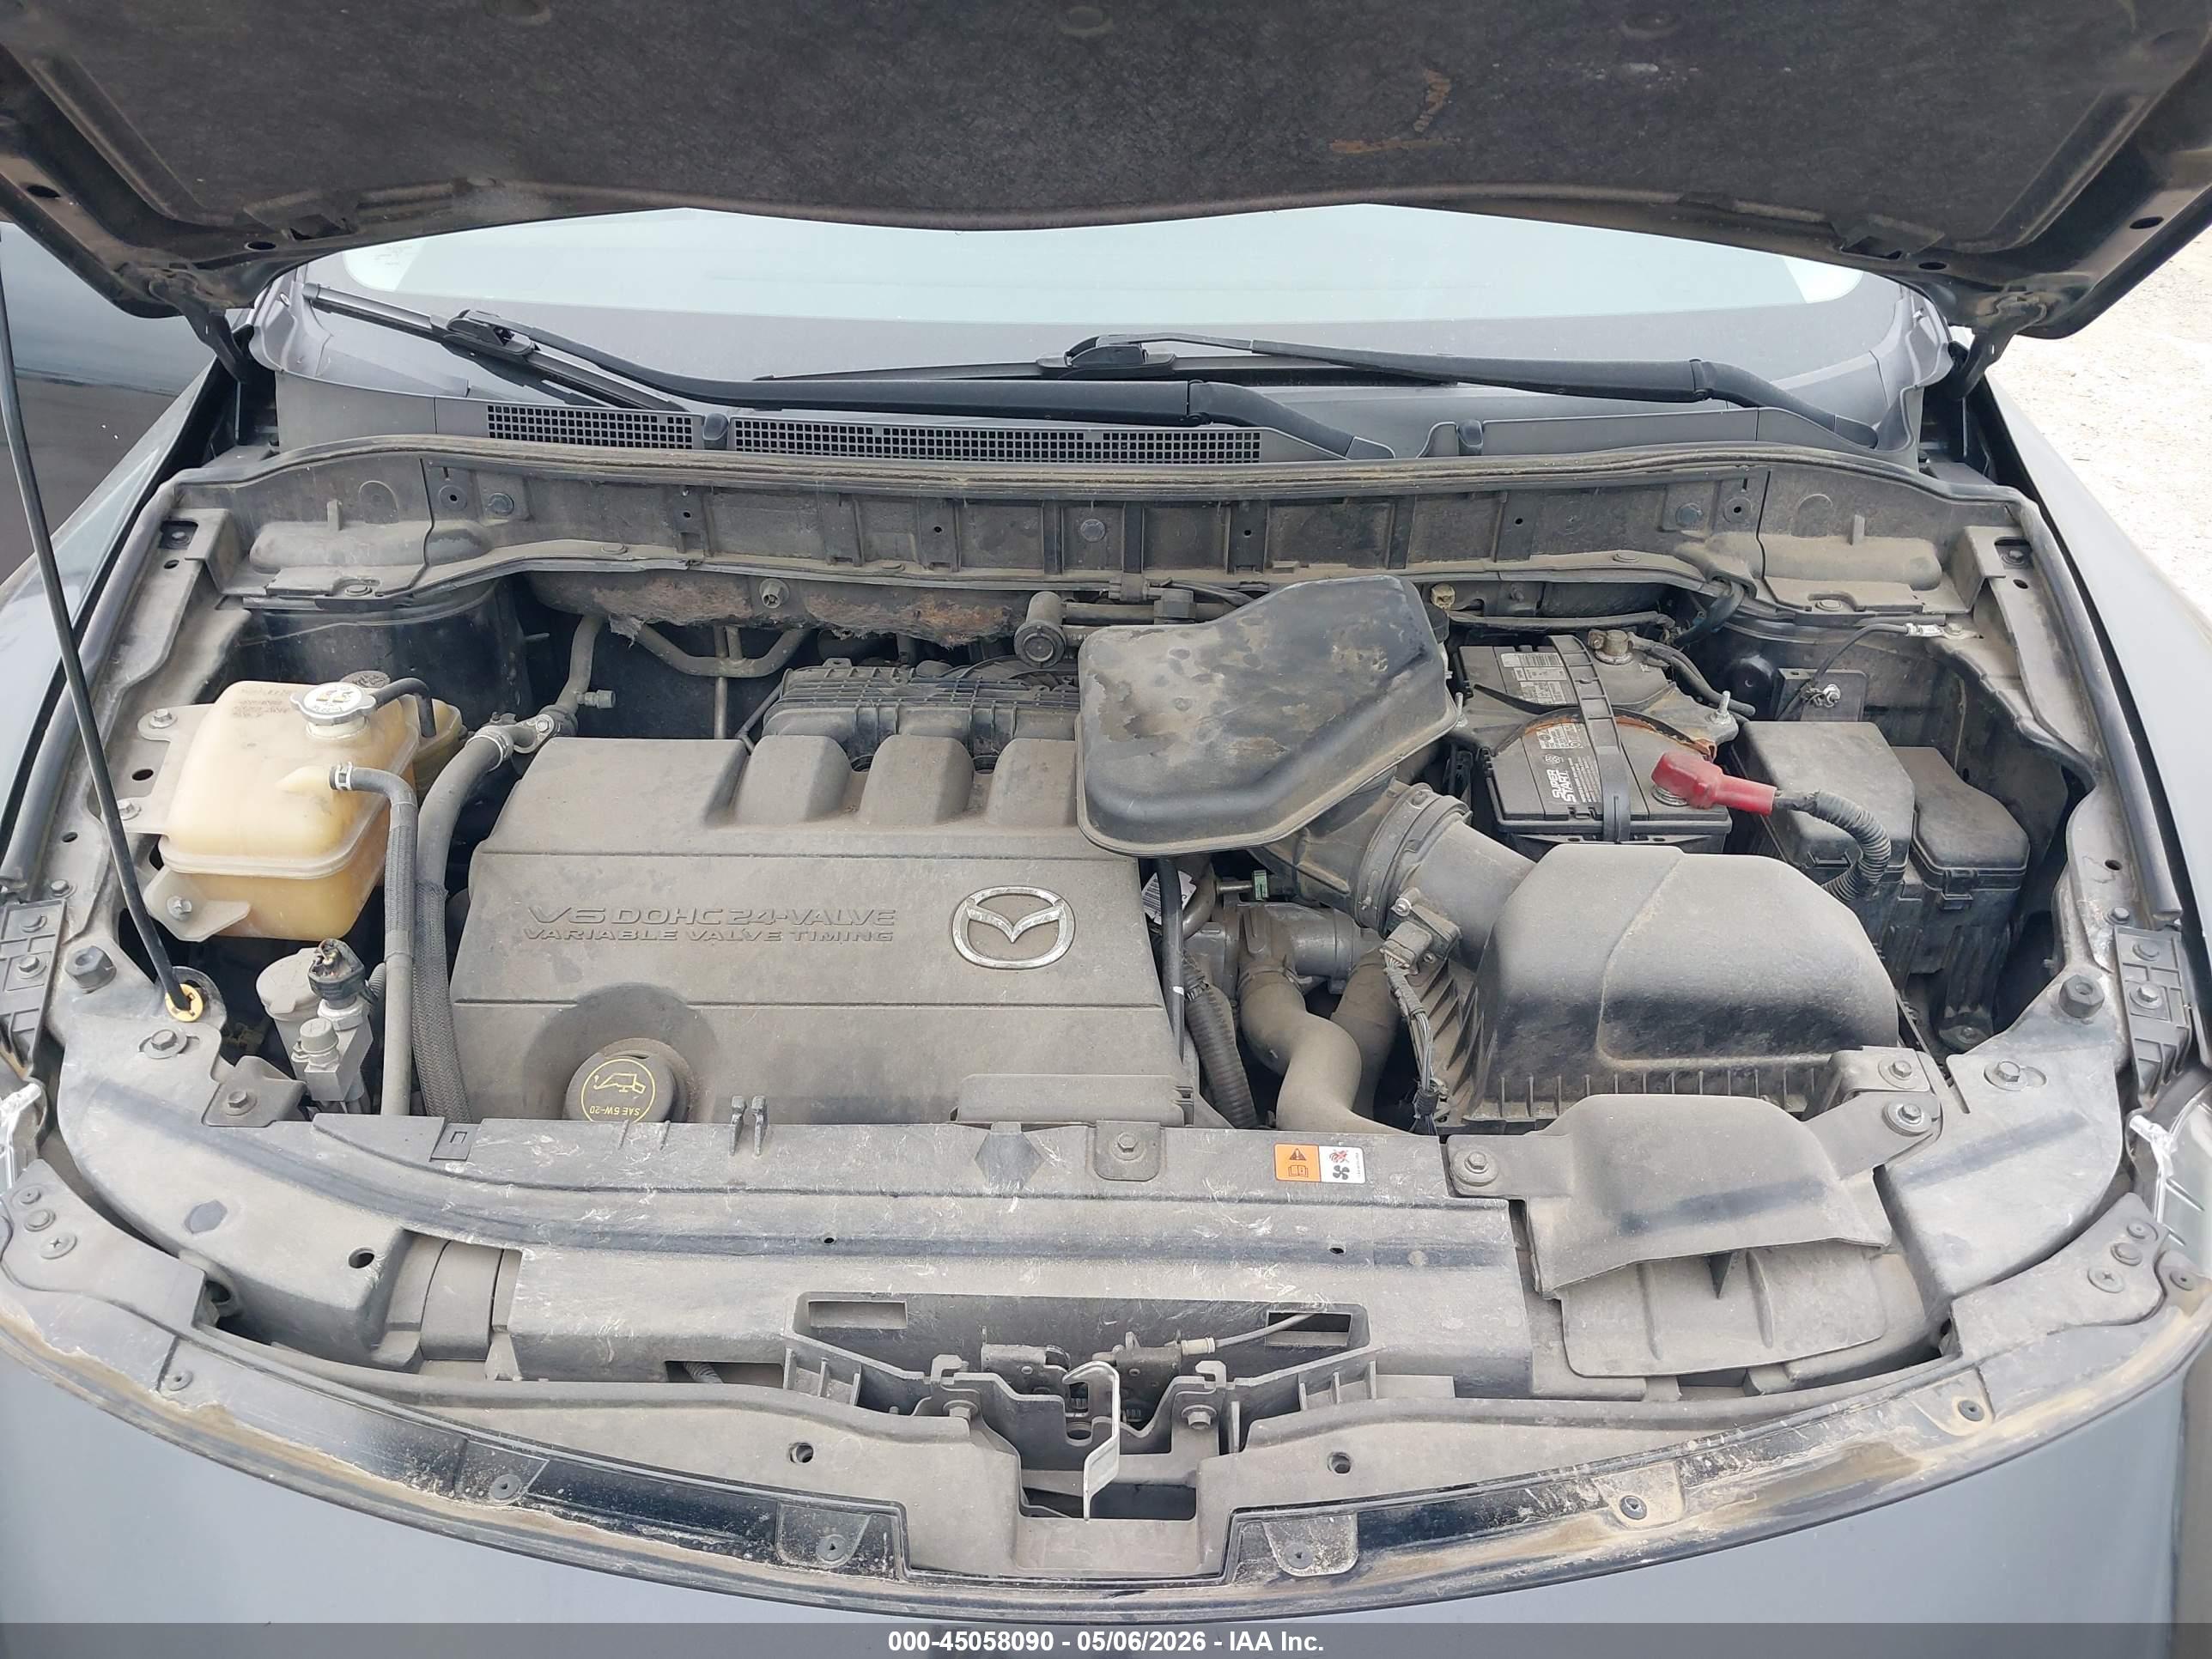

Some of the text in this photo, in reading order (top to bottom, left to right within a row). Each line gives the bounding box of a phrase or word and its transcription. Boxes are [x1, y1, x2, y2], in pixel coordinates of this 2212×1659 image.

[1547, 769, 1563, 799] SUPER
[1556, 769, 1577, 803] START
[527, 906, 896, 926] V6 DOHC 24-VALVE
[523, 927, 894, 942] VARIABLE VALVE TIMING
[589, 1105, 641, 1116] SAE 5W-20
